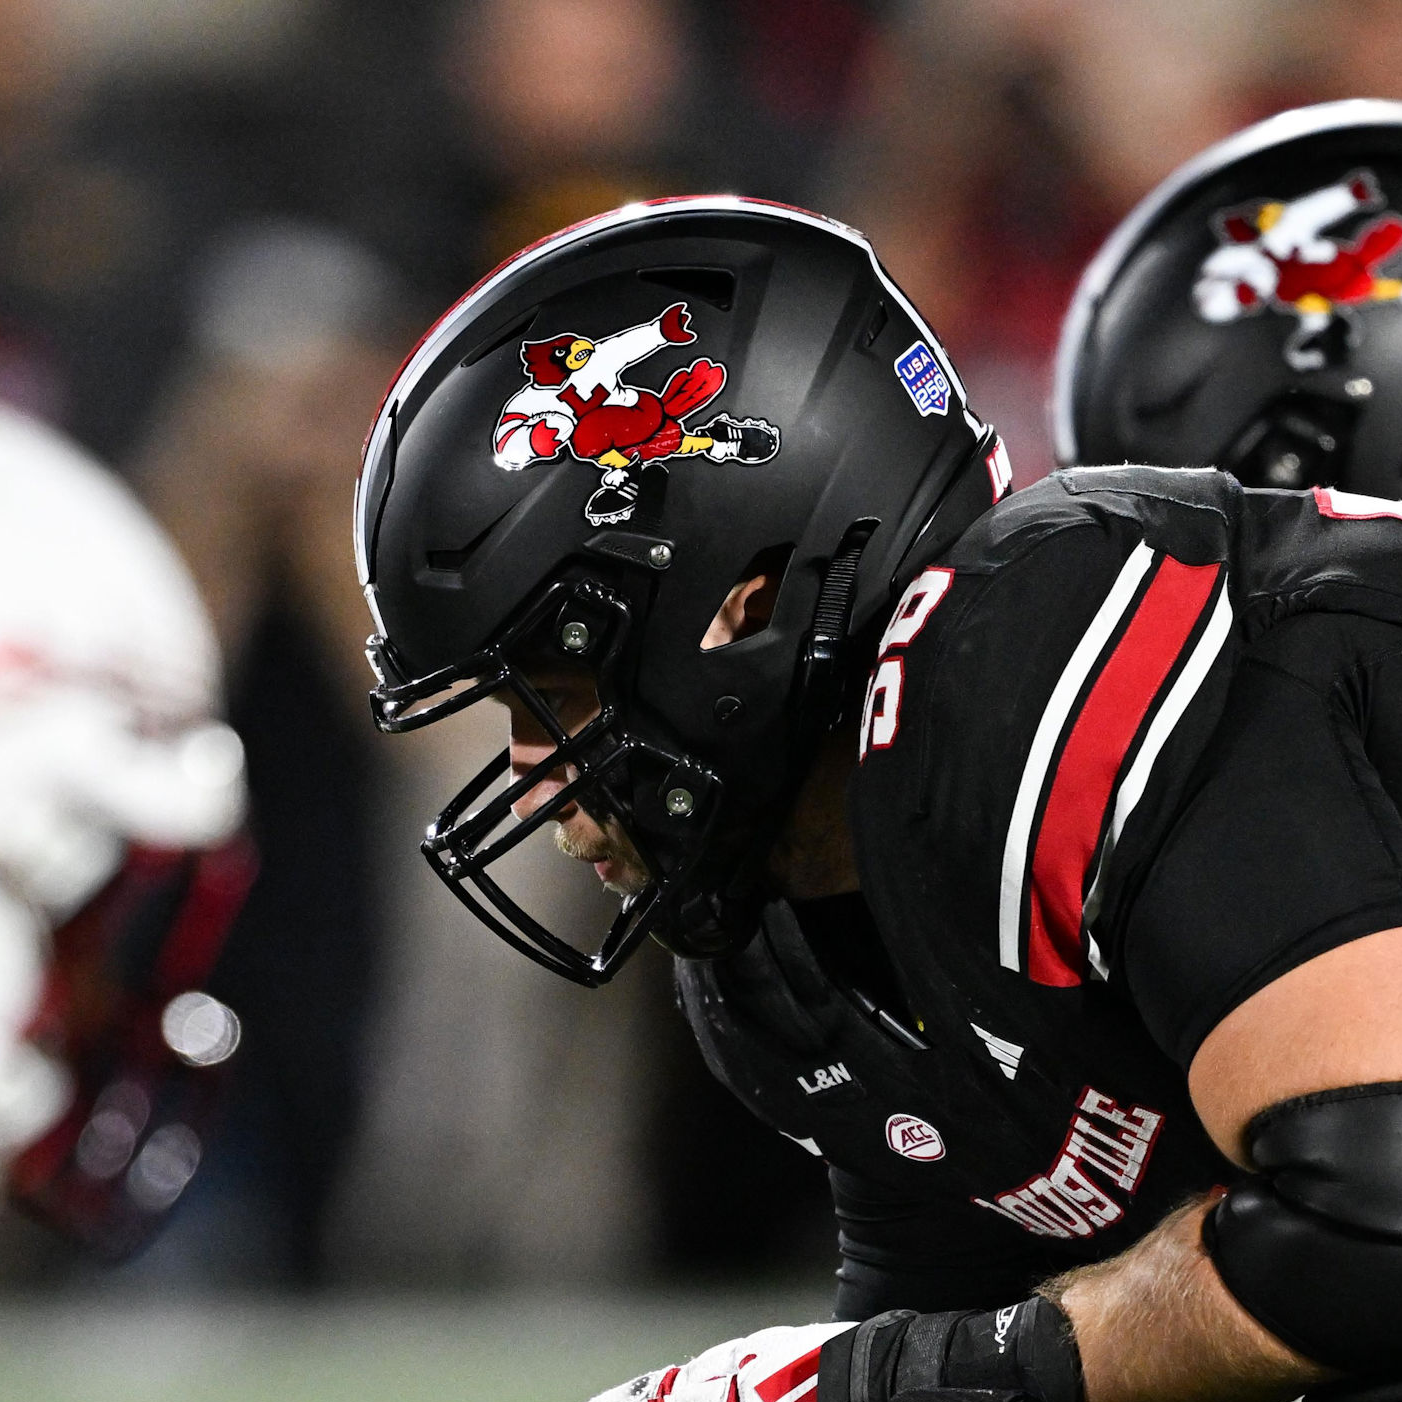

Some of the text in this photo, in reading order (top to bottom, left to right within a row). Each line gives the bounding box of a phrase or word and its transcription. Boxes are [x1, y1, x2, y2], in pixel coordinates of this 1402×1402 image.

[902, 352, 931, 380] USA
[915, 373, 947, 409] 250
[797, 1062, 852, 1095] L&N
[901, 1124, 933, 1148] ACC
